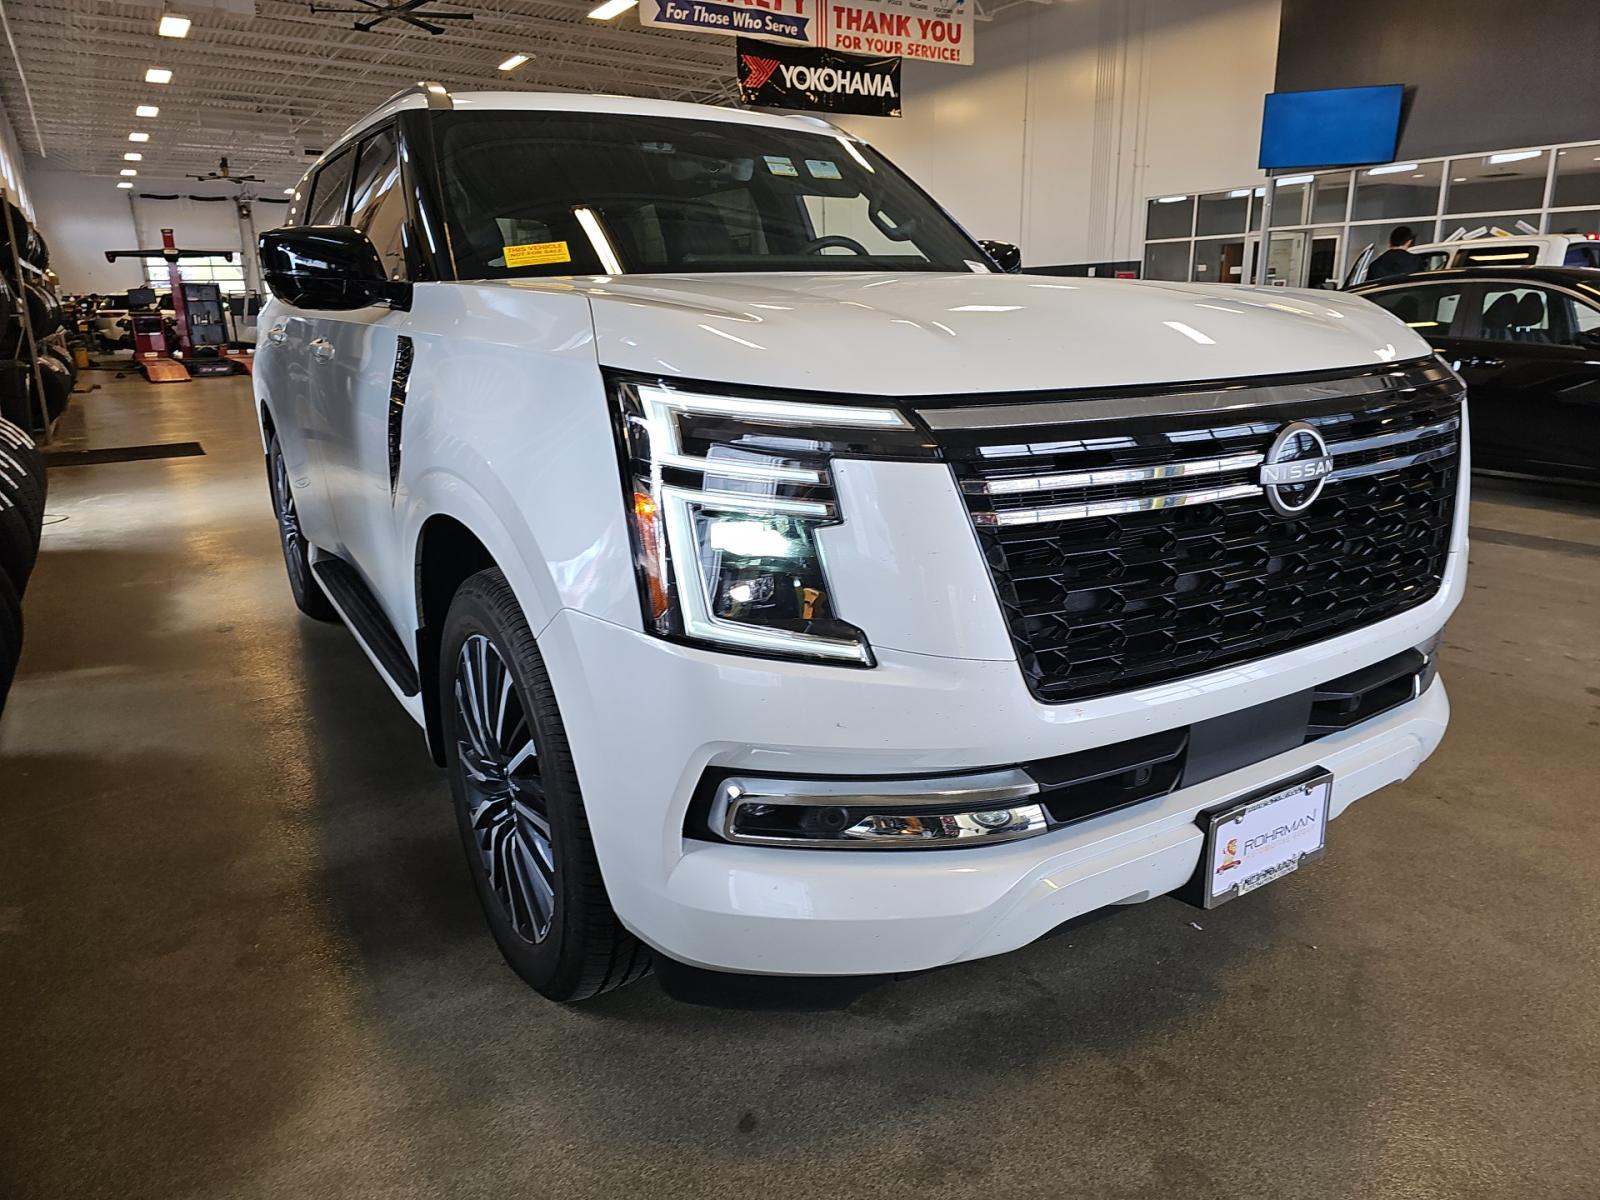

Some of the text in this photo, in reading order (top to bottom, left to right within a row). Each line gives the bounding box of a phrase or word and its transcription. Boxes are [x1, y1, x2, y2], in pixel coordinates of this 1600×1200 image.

[666, 3, 689, 20] For
[693, 6, 729, 25] Those
[733, 12, 762, 30] Who
[765, 17, 797, 36] Serve
[833, 5, 911, 38] THANK
[917, 18, 962, 45] YOU
[836, 34, 960, 62] FOR YOUR SERVICE!
[780, 63, 896, 98] YOKOHAMA
[1263, 460, 1332, 481] NISSAN
[1244, 808, 1317, 856] ROHRMAN
